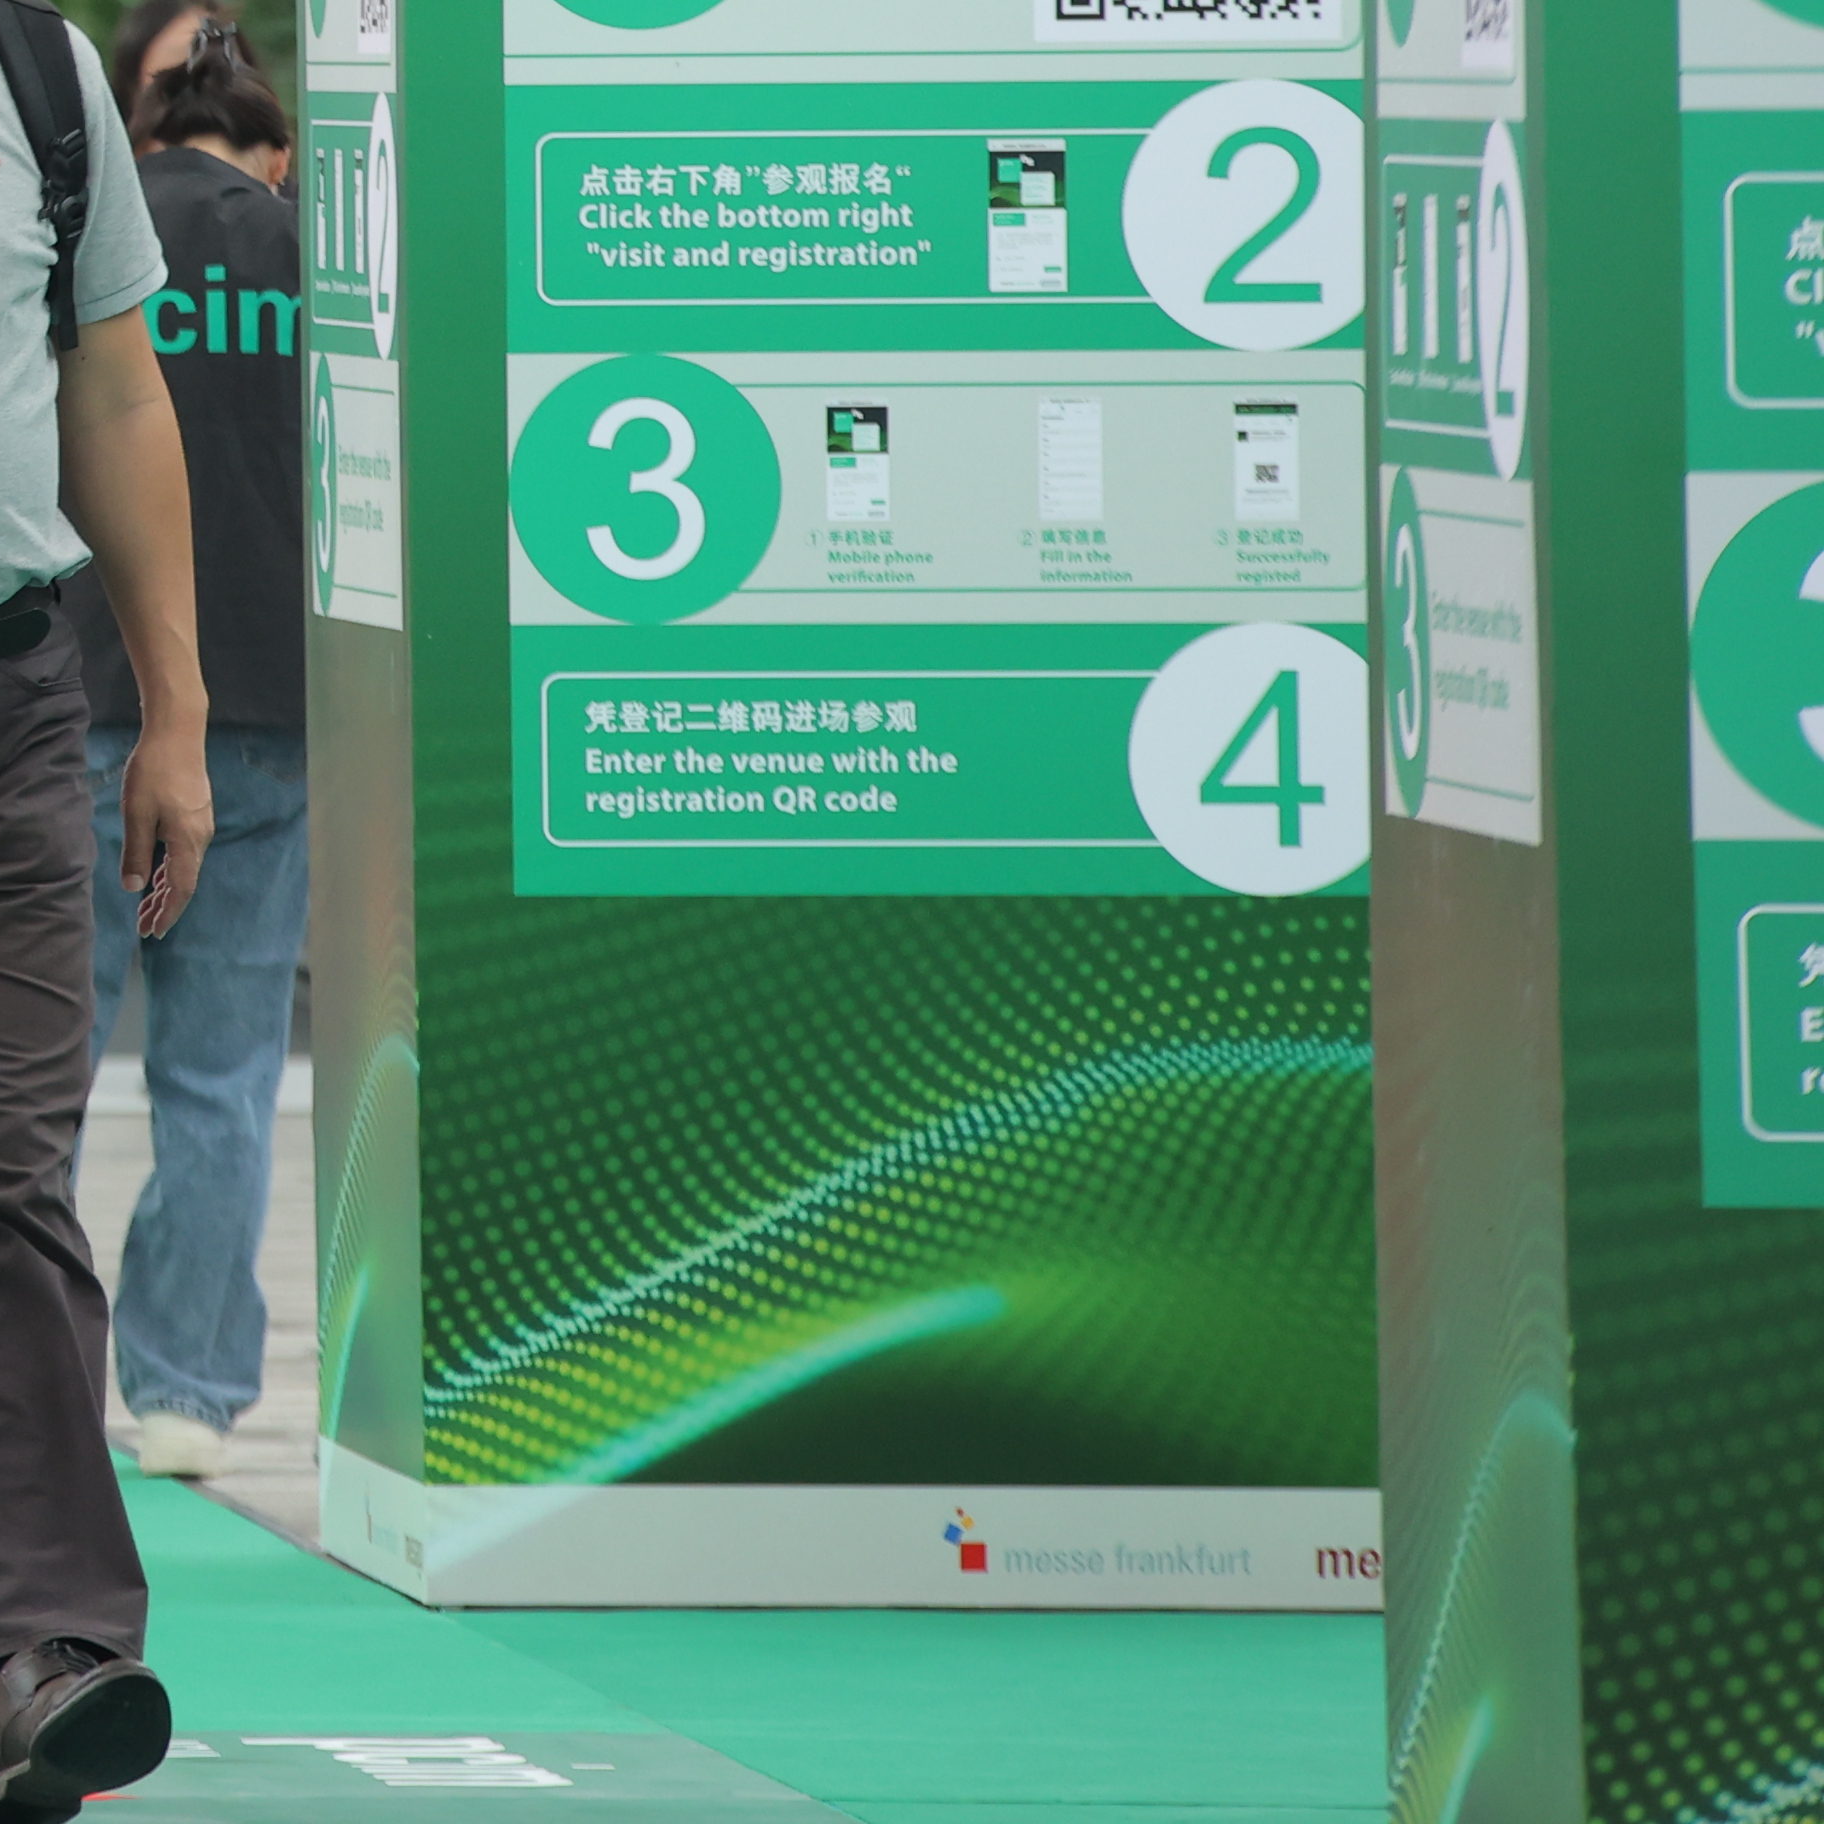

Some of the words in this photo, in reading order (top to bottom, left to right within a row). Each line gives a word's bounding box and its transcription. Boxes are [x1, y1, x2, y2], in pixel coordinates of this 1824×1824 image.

[579, 202, 654, 230] Click
[659, 202, 710, 230] the
[717, 202, 831, 229] bottom
[838, 201, 914, 234] right
[1204, 127, 1323, 304] 2
[586, 241, 666, 268] "visit
[672, 241, 731, 268] and
[738, 240, 933, 274] registration"
[1490, 181, 1516, 418] 2
[586, 397, 706, 581] 3
[828, 550, 881, 564] Mobile
[884, 550, 934, 566] phone
[1040, 549, 1064, 564] Fill
[1068, 549, 1083, 564] in
[1087, 549, 1113, 564] the
[827, 570, 916, 584] verification
[1394, 522, 1422, 761] 3
[584, 699, 918, 734] 凭登记二维码进场参观
[585, 748, 667, 774] Enter
[673, 746, 725, 774] the
[731, 752, 825, 774] venue
[831, 746, 900, 774] with
[906, 746, 959, 774] the
[1199, 670, 1326, 848] 4
[585, 785, 765, 819] registration
[772, 786, 818, 815] QR
[823, 785, 899, 813] code
[1004, 1547, 1106, 1575] messe
[1115, 1542, 1252, 1576] frankfurt
